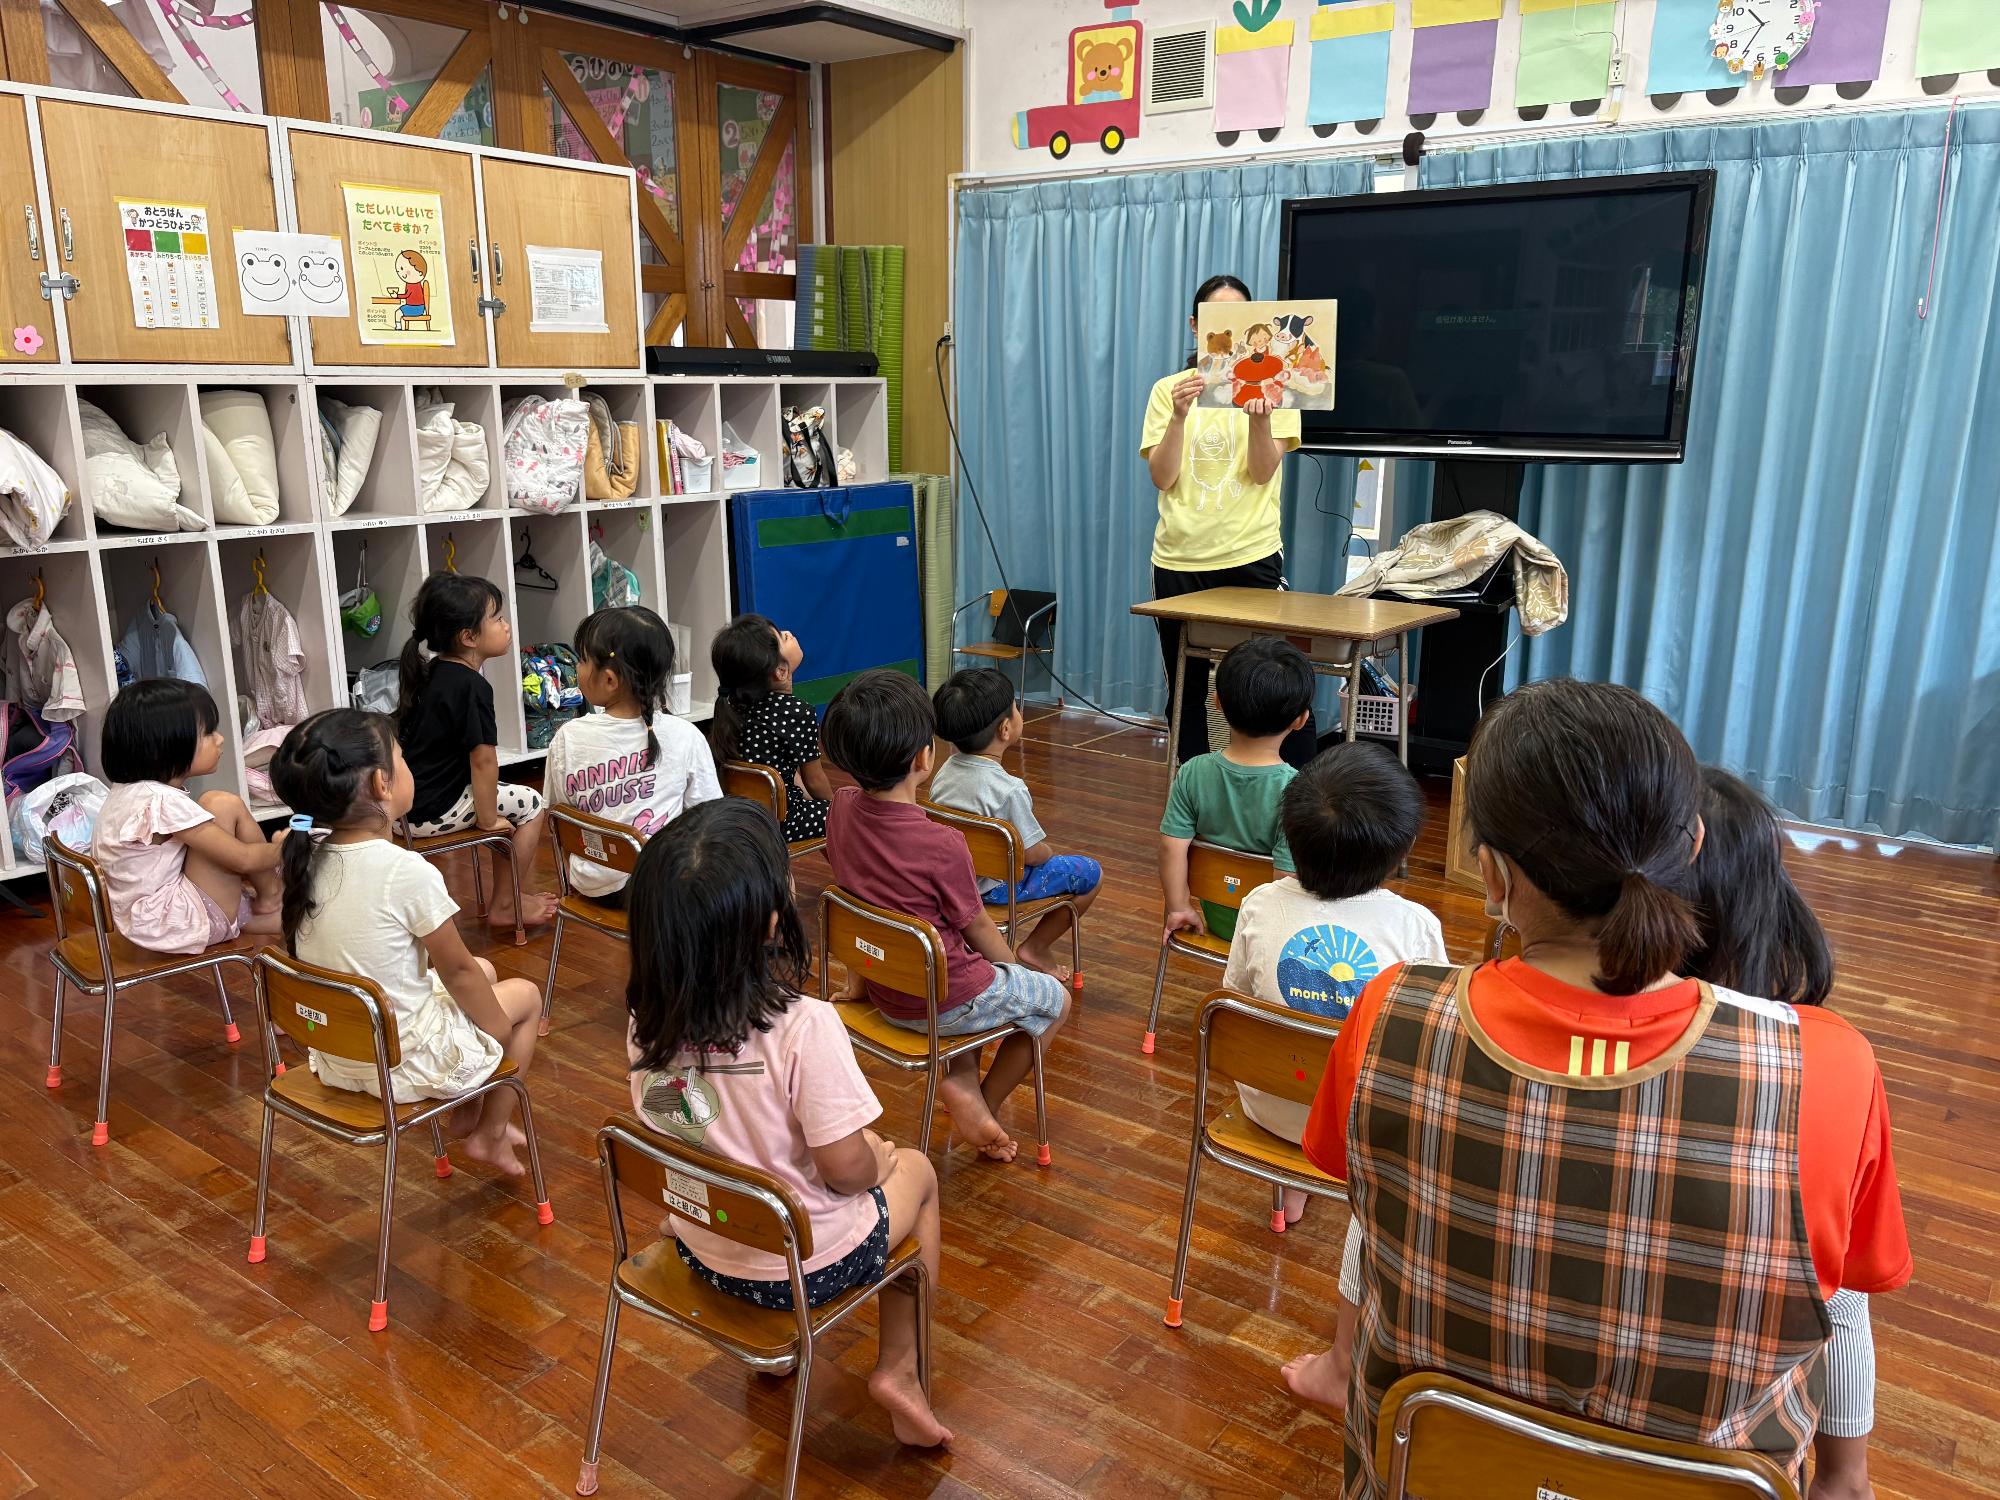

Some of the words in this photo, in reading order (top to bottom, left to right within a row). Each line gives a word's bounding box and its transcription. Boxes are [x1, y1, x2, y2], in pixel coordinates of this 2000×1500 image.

[1732, 8, 1745, 17] 10
[1726, 24, 1734, 33] 9
[1786, 32, 1794, 41] 4
[1730, 40, 1738, 49] 8
[1773, 46, 1782, 56] 5
[1757, 52, 1765, 62] 6
[144, 206, 184, 218] おとうばん
[355, 202, 434, 220] ただしいしせいで
[139, 217, 192, 231] かつどうひょう
[772, 355, 792, 364] YAMAHA
